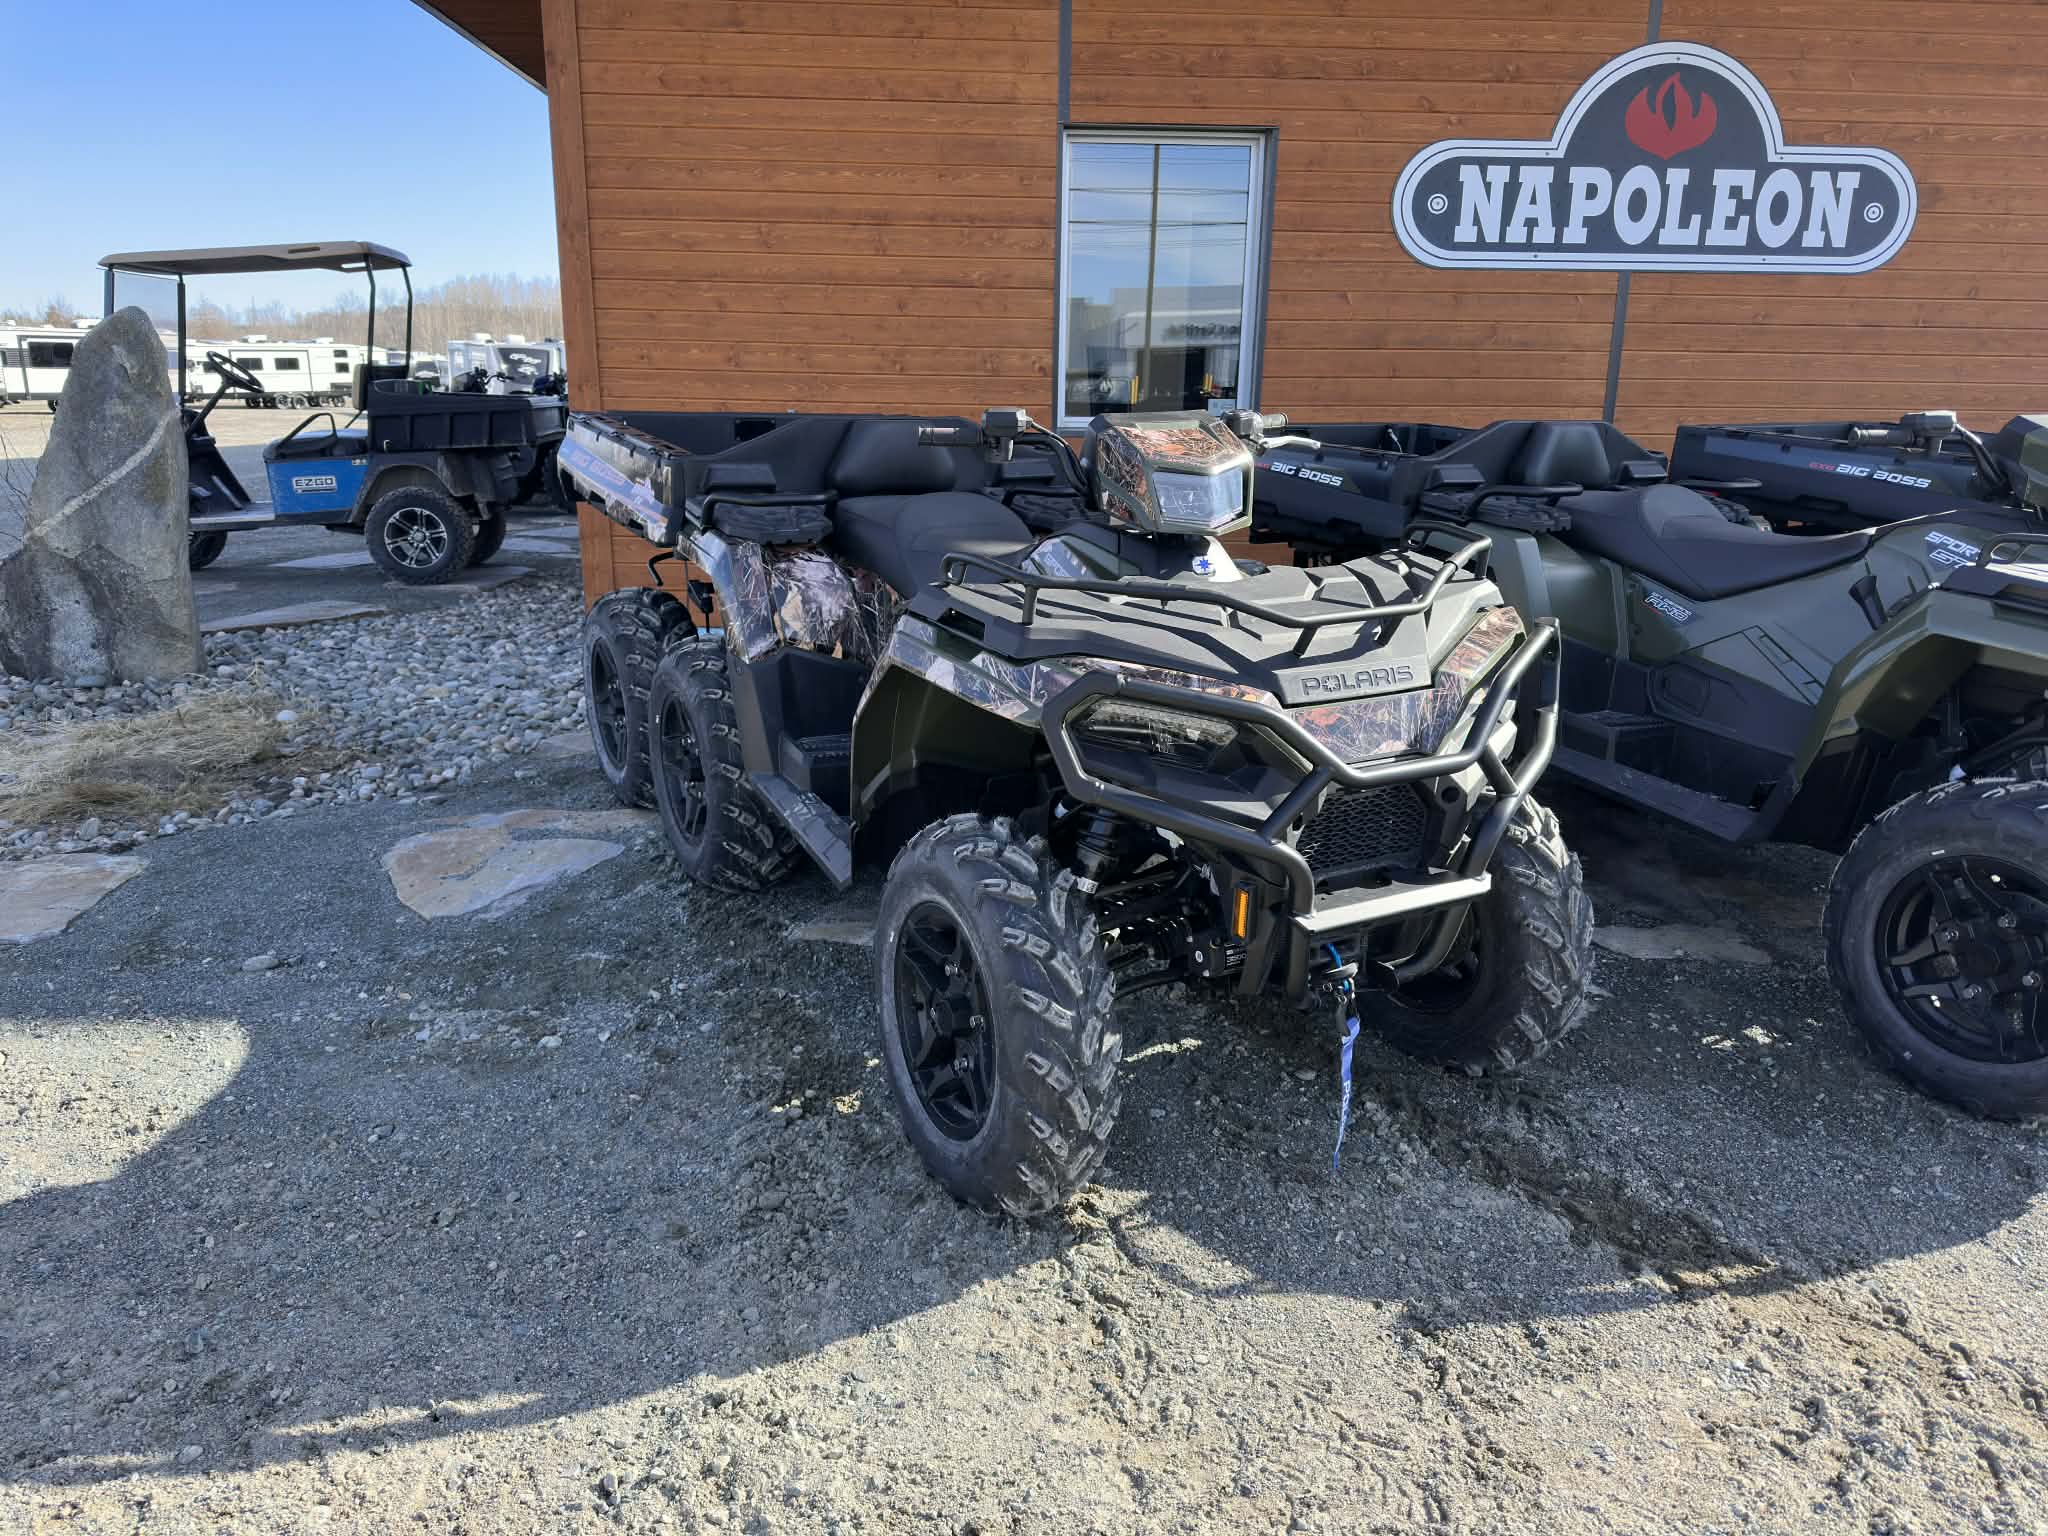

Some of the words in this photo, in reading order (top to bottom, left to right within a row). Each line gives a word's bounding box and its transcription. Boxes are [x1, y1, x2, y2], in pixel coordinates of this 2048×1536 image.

[1453, 164, 1861, 248] NAPOLEON
[1270, 462, 1297, 475] BIG
[1298, 468, 1344, 486] BOSS
[1835, 464, 1871, 477] BIG
[1872, 470, 1932, 488] BOSS
[1301, 665, 1414, 696] POLARIS
